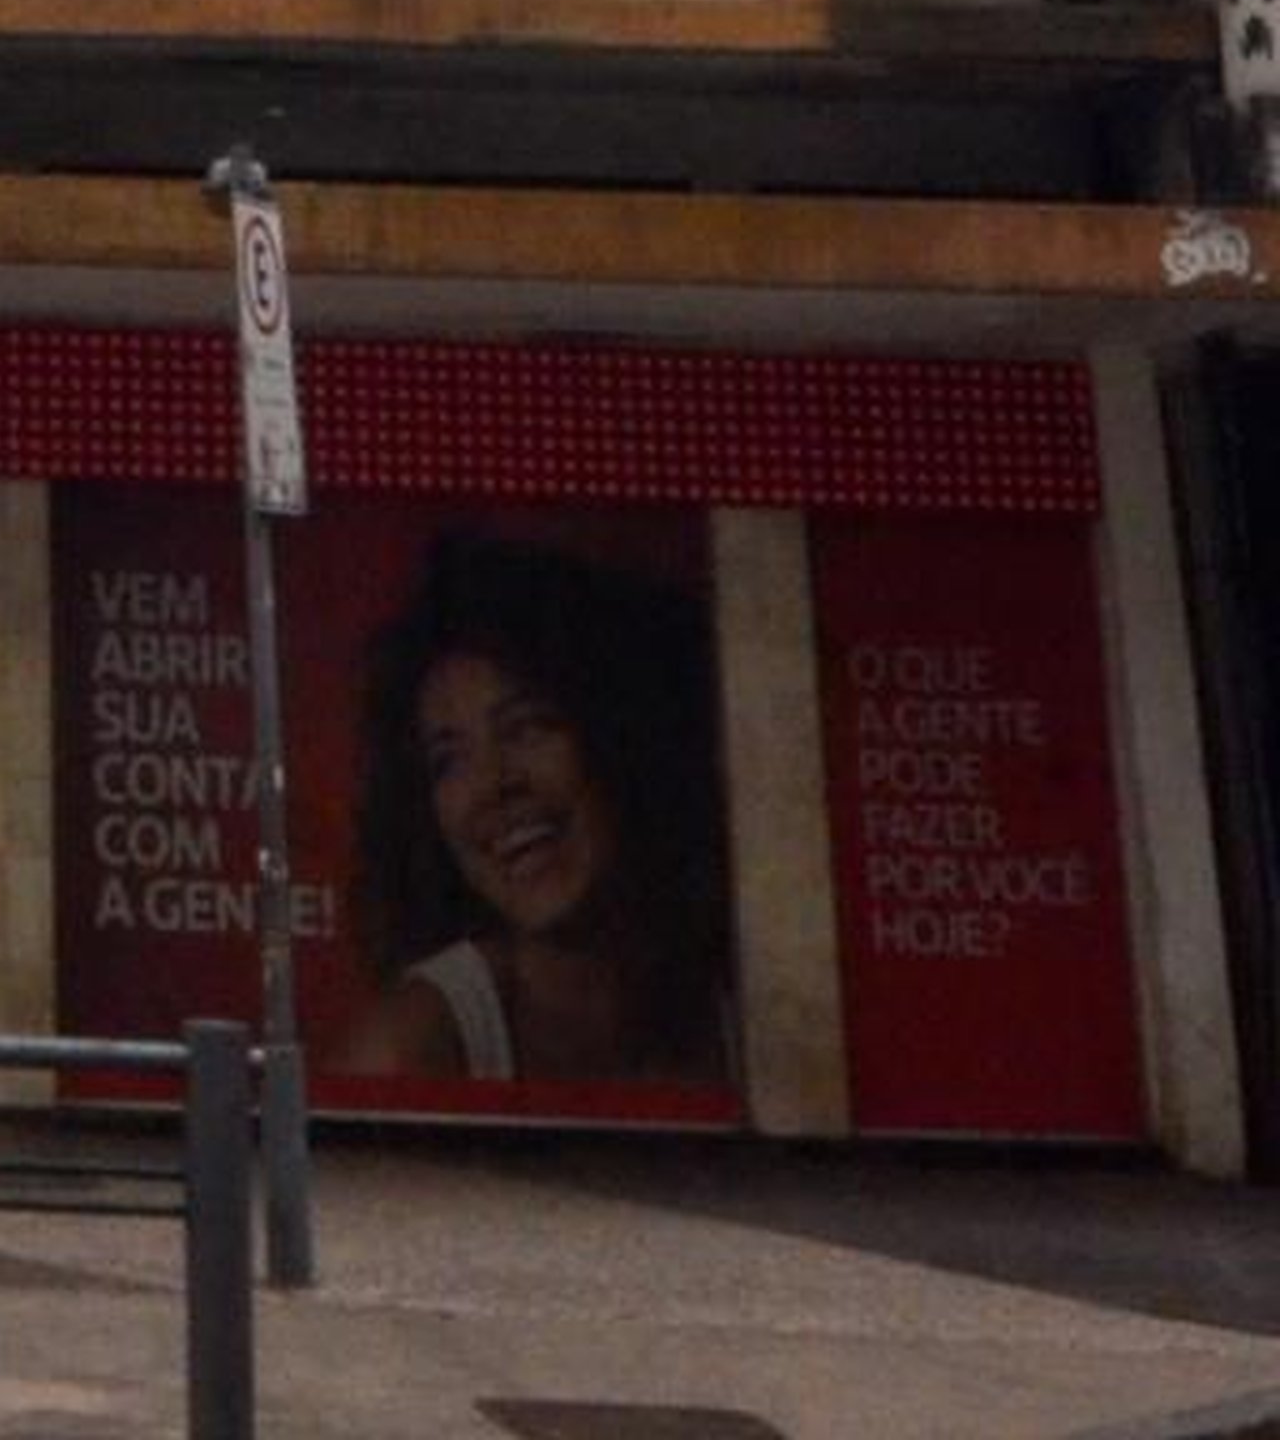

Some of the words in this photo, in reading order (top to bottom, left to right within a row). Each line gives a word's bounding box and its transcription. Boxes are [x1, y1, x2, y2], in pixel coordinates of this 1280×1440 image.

[90, 570, 208, 625] VEM
[91, 630, 250, 687] ABRIR
[846, 646, 887, 689] O
[893, 647, 993, 693] QUE
[92, 689, 202, 743] SUA
[894, 699, 1045, 746] GENTE
[859, 749, 986, 796] PODE
[93, 812, 223, 871] COM
[862, 801, 1007, 848] FAZER
[866, 852, 962, 899] POR
[93, 875, 136, 928] A
[143, 878, 336, 942] GENE!
[872, 908, 1011, 956] HOJE?
